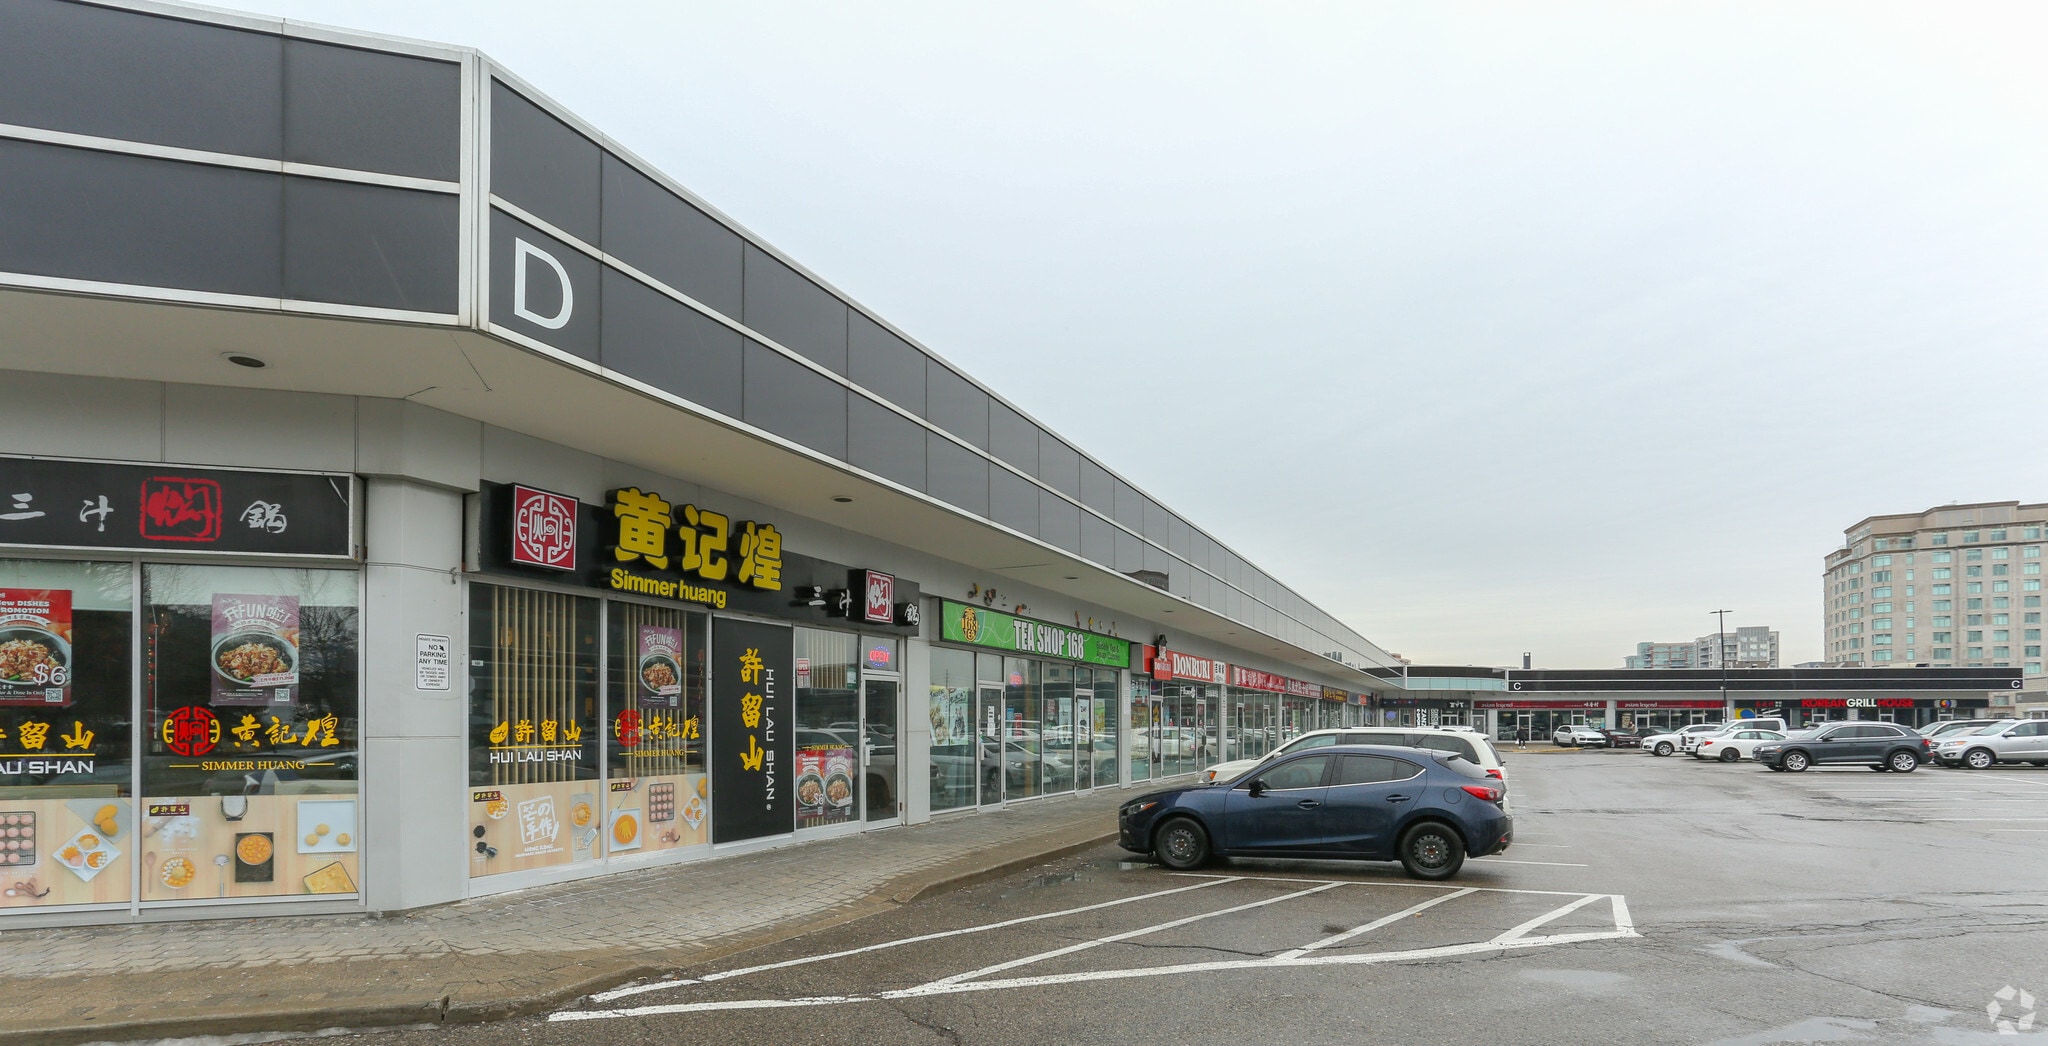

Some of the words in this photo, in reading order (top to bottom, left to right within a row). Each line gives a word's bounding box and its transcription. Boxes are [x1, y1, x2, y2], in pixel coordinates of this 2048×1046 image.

[514, 237, 573, 329] D
[614, 488, 782, 591] 黄记煌
[611, 568, 678, 597] Simmer
[679, 580, 727, 609] huang
[1013, 620, 1036, 652] TEA
[1037, 624, 1065, 657] SHOP
[1066, 631, 1084, 660] 168
[869, 650, 889, 662] OPEN
[1173, 653, 1211, 680] DONBURI
[33, 663, 67, 686] $6
[765, 669, 775, 699] HUI
[1513, 682, 1522, 690] C
[2011, 679, 2020, 689] C
[739, 648, 764, 771] 許留山
[1801, 698, 1846, 708] KOREAN
[1846, 698, 1877, 708] GRILL
[1877, 698, 1914, 708] HOUSE
[0, 720, 95, 750] 留山
[514, 719, 582, 744] 許留山
[765, 707, 775, 742] LAU
[202, 760, 255, 771] SIMMER
[257, 760, 305, 770] HUANG
[489, 752, 514, 764] HUI
[517, 750, 544, 763] LAU
[546, 749, 582, 761] SHAN
[634, 749, 660, 758] SIMMER
[661, 748, 684, 757] HUANG
[28, 760, 94, 774] SHAN
[765, 750, 775, 800] SHAN
